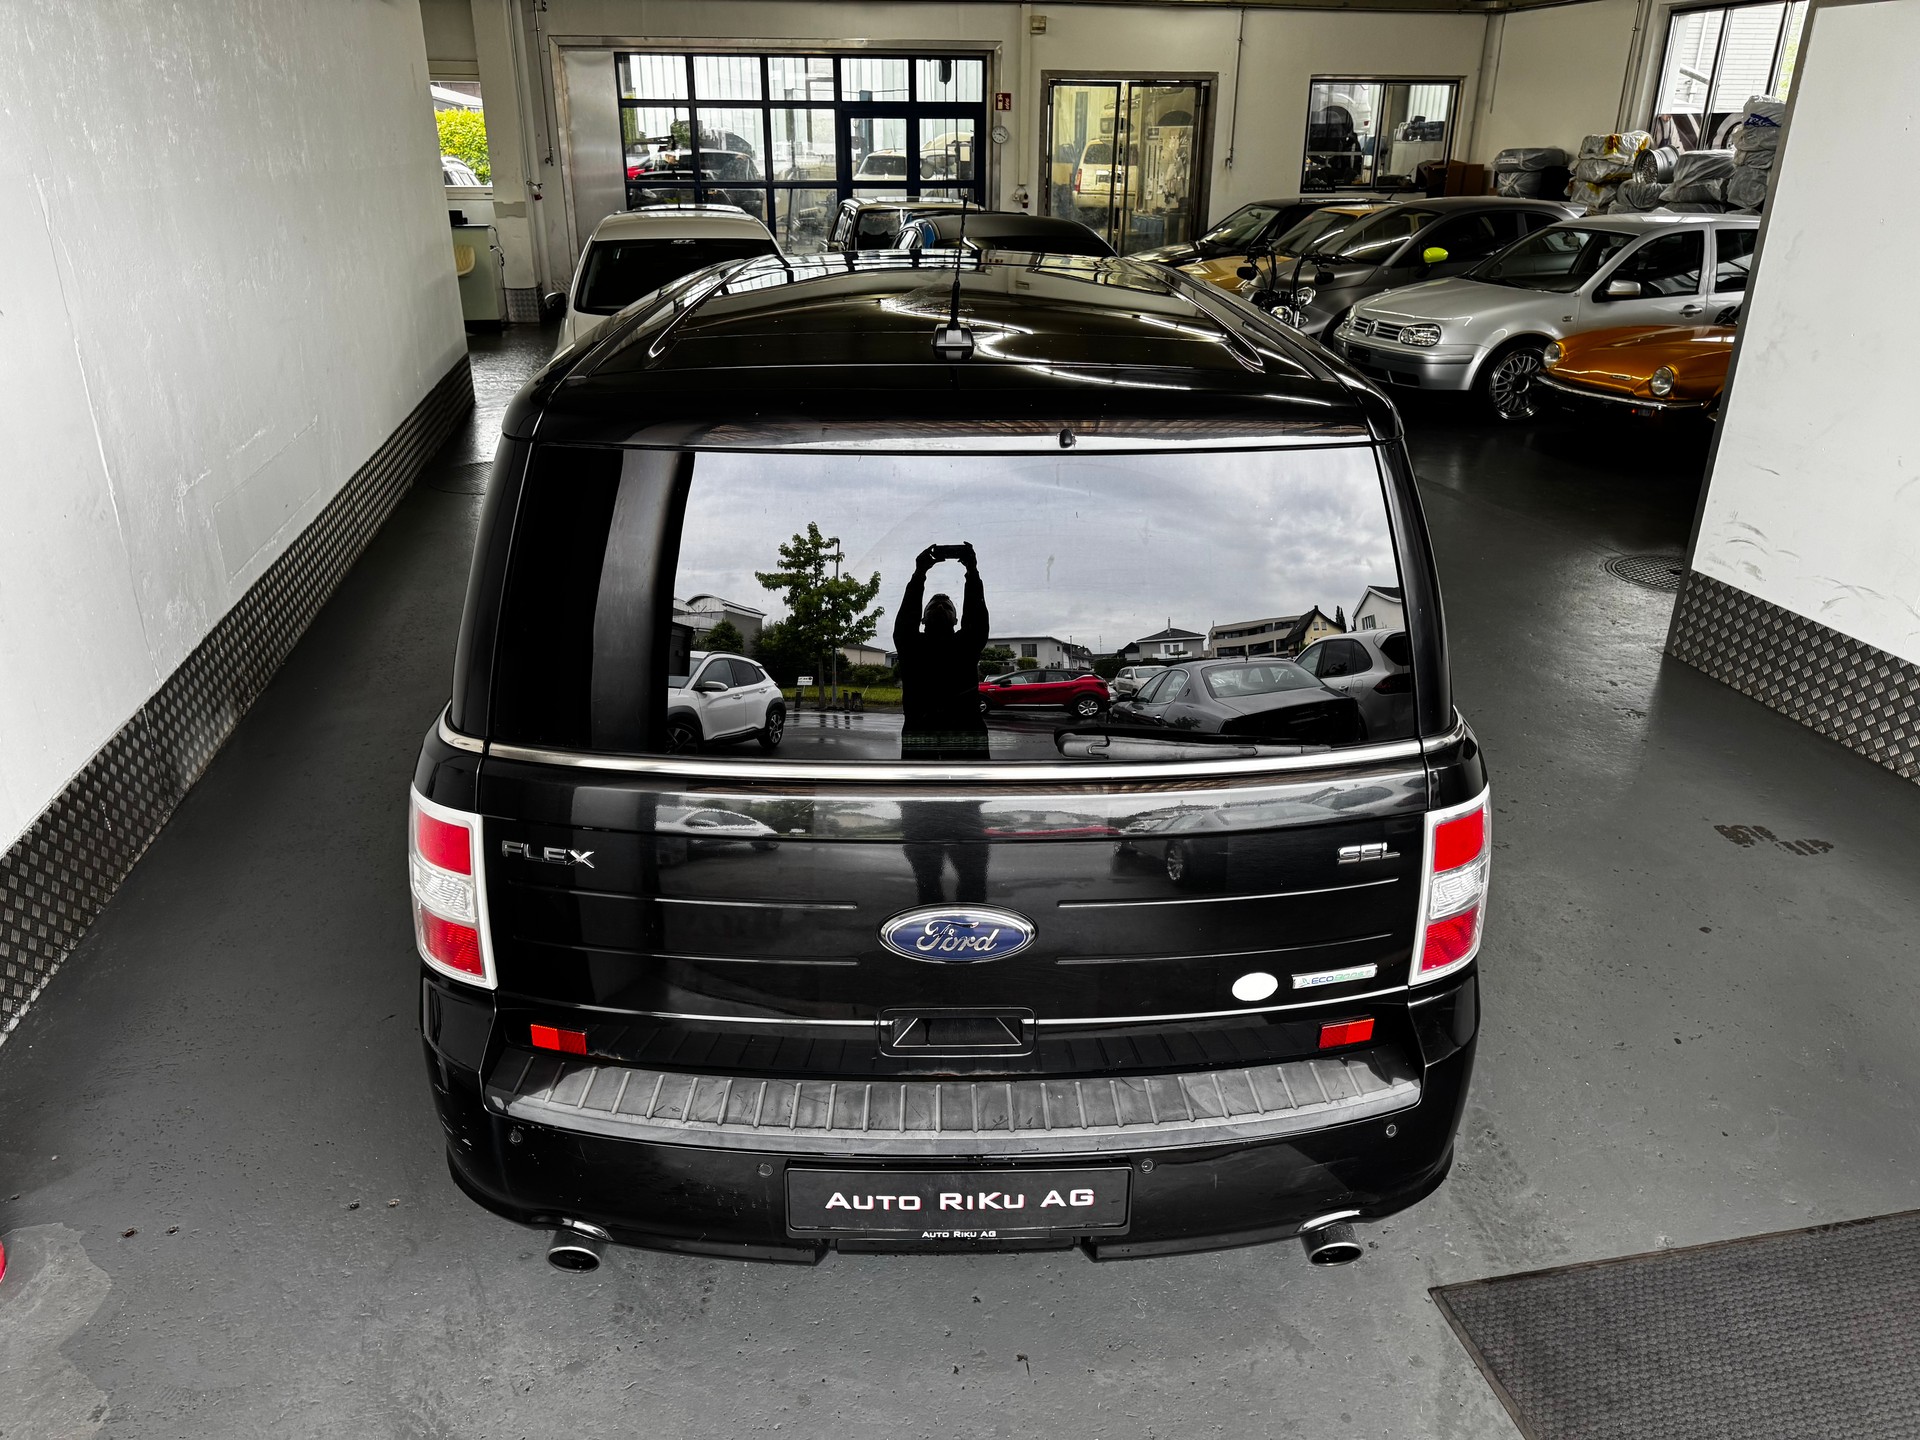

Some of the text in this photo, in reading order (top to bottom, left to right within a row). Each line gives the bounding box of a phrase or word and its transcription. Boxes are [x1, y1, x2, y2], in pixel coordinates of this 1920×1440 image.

[502, 840, 595, 868] FLEX
[1337, 842, 1400, 864] SEL
[916, 919, 999, 951] Ford
[825, 1192, 922, 1211] AUTO
[1040, 1189, 1095, 1208] AG
[921, 1230, 950, 1238] AUTO
[980, 1230, 997, 1238] AG
